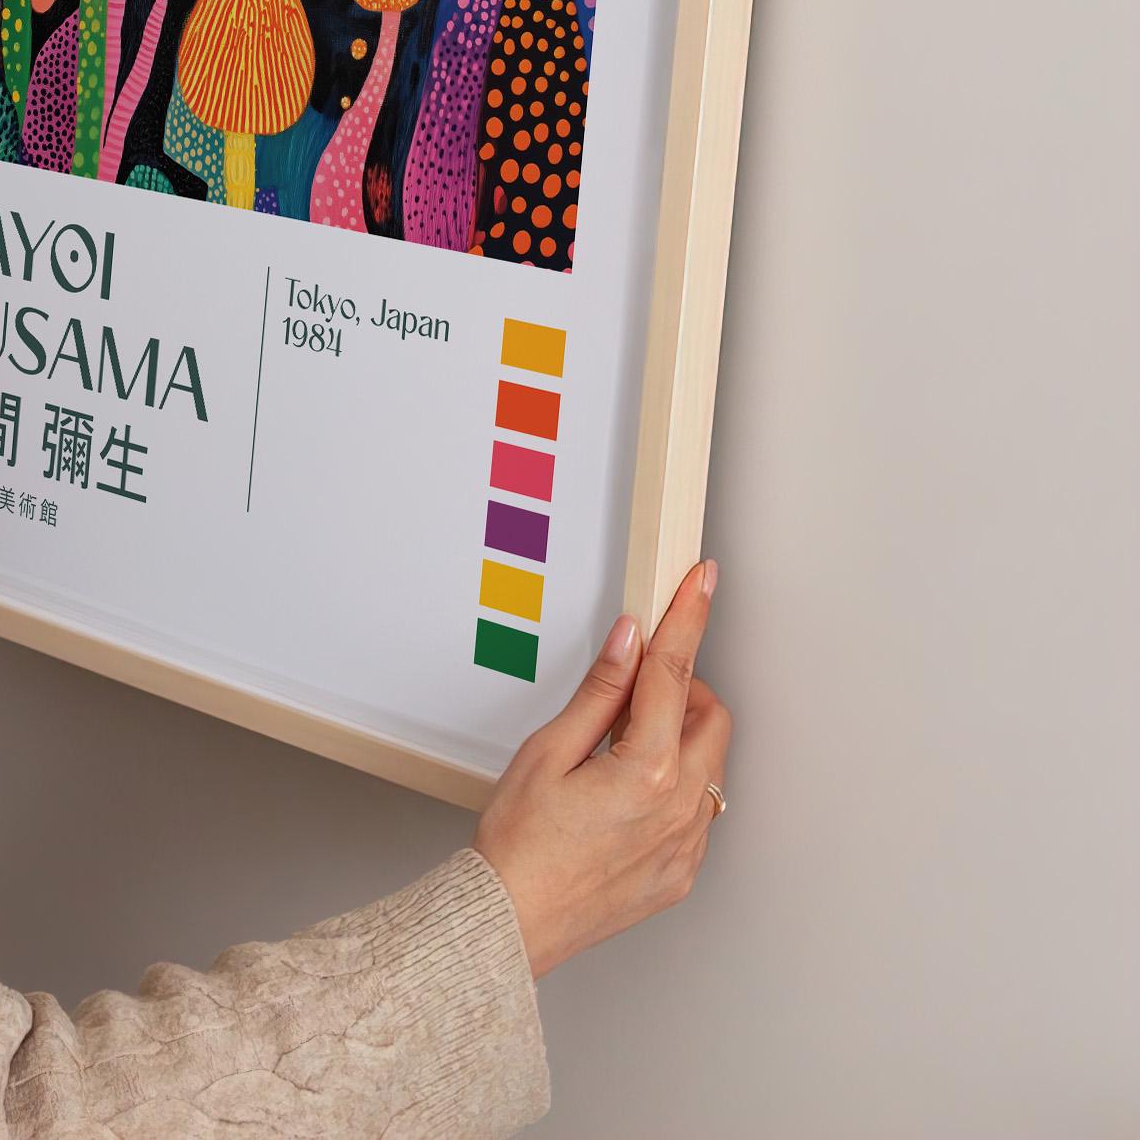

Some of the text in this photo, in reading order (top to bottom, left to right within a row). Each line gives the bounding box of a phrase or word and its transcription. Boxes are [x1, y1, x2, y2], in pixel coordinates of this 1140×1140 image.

[282, 316, 343, 358] 1984
[284, 277, 451, 343] Tokyo, Japan
[41, 402, 149, 504] 彌生
